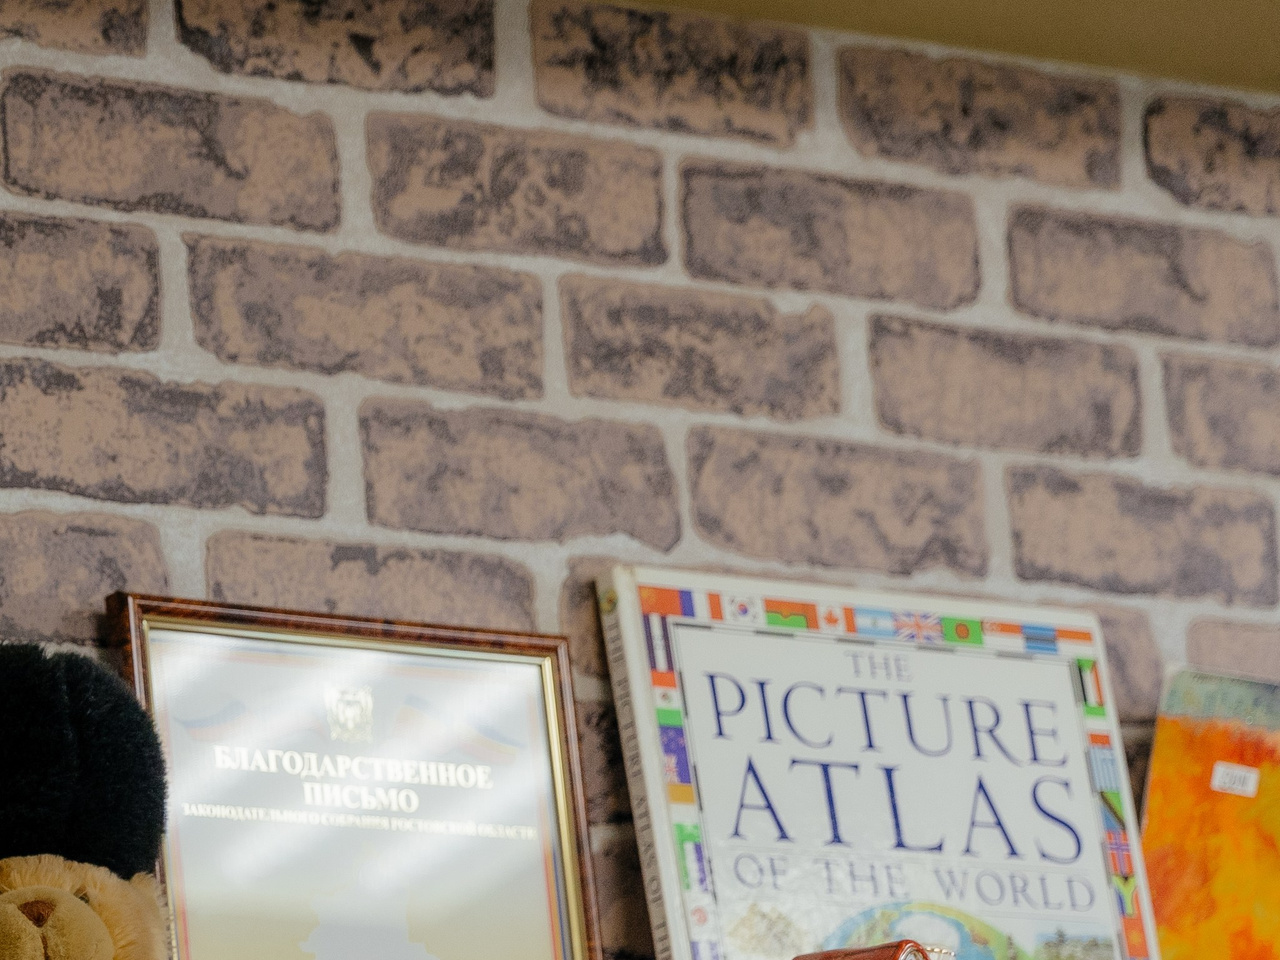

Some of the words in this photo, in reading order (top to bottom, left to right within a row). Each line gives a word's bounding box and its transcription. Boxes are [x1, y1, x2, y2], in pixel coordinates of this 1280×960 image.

[845, 650, 914, 682] THE
[706, 671, 1069, 768] PICTURE
[213, 745, 494, 790] БЛАГОДАРСТВЕННОЕ
[302, 781, 420, 813] ПИСЬМО
[729, 755, 1083, 865] ATLAS
[733, 852, 789, 890] OF
[814, 858, 910, 900] THE
[933, 866, 1097, 913] WORLD
